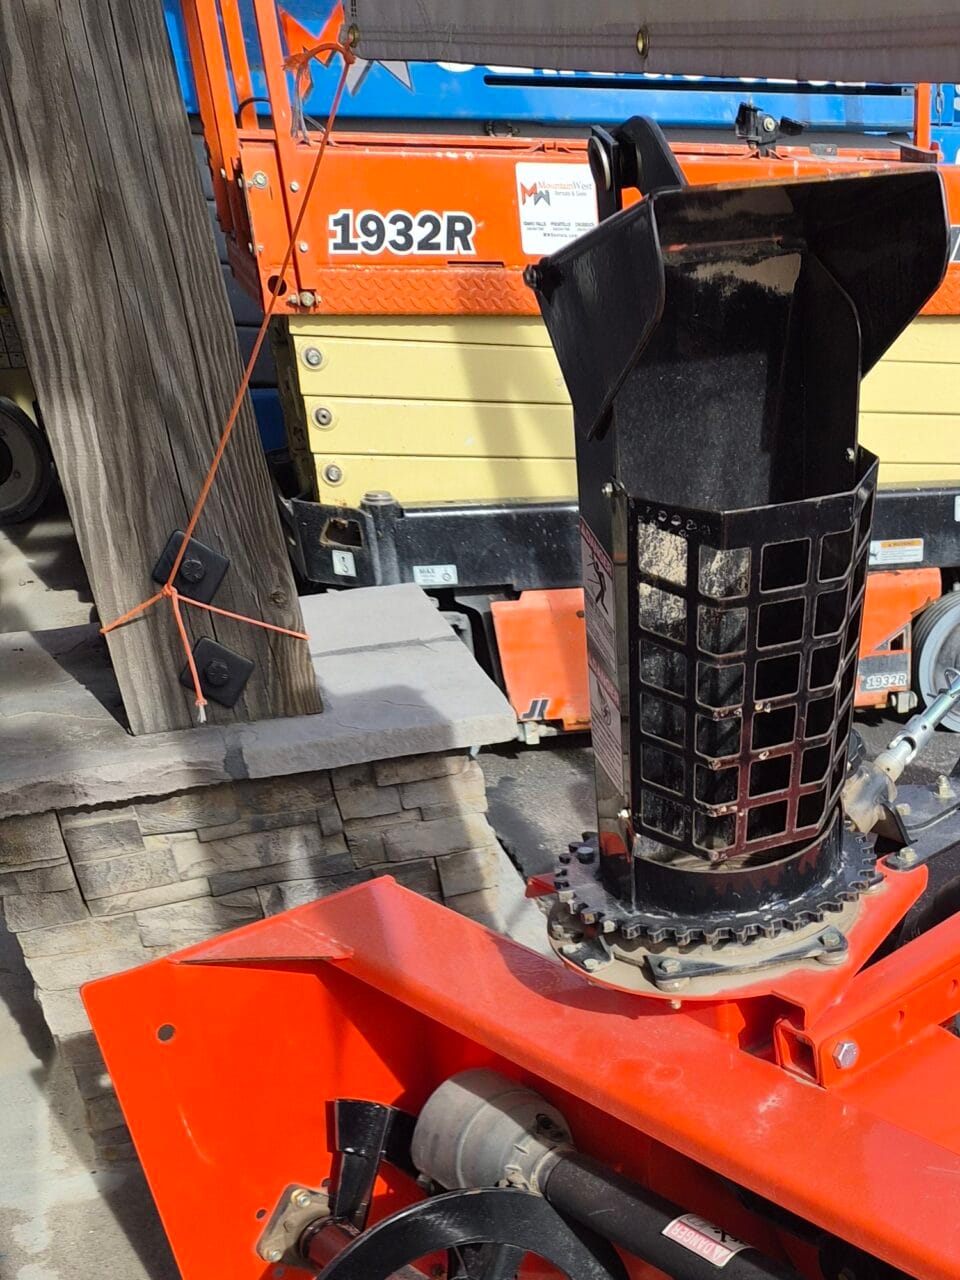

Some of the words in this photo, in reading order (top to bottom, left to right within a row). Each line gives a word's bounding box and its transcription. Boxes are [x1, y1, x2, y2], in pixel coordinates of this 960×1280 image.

[331, 211, 475, 253] 1932R
[866, 673, 907, 689] 1932R
[671, 1222, 714, 1254] DANGER
